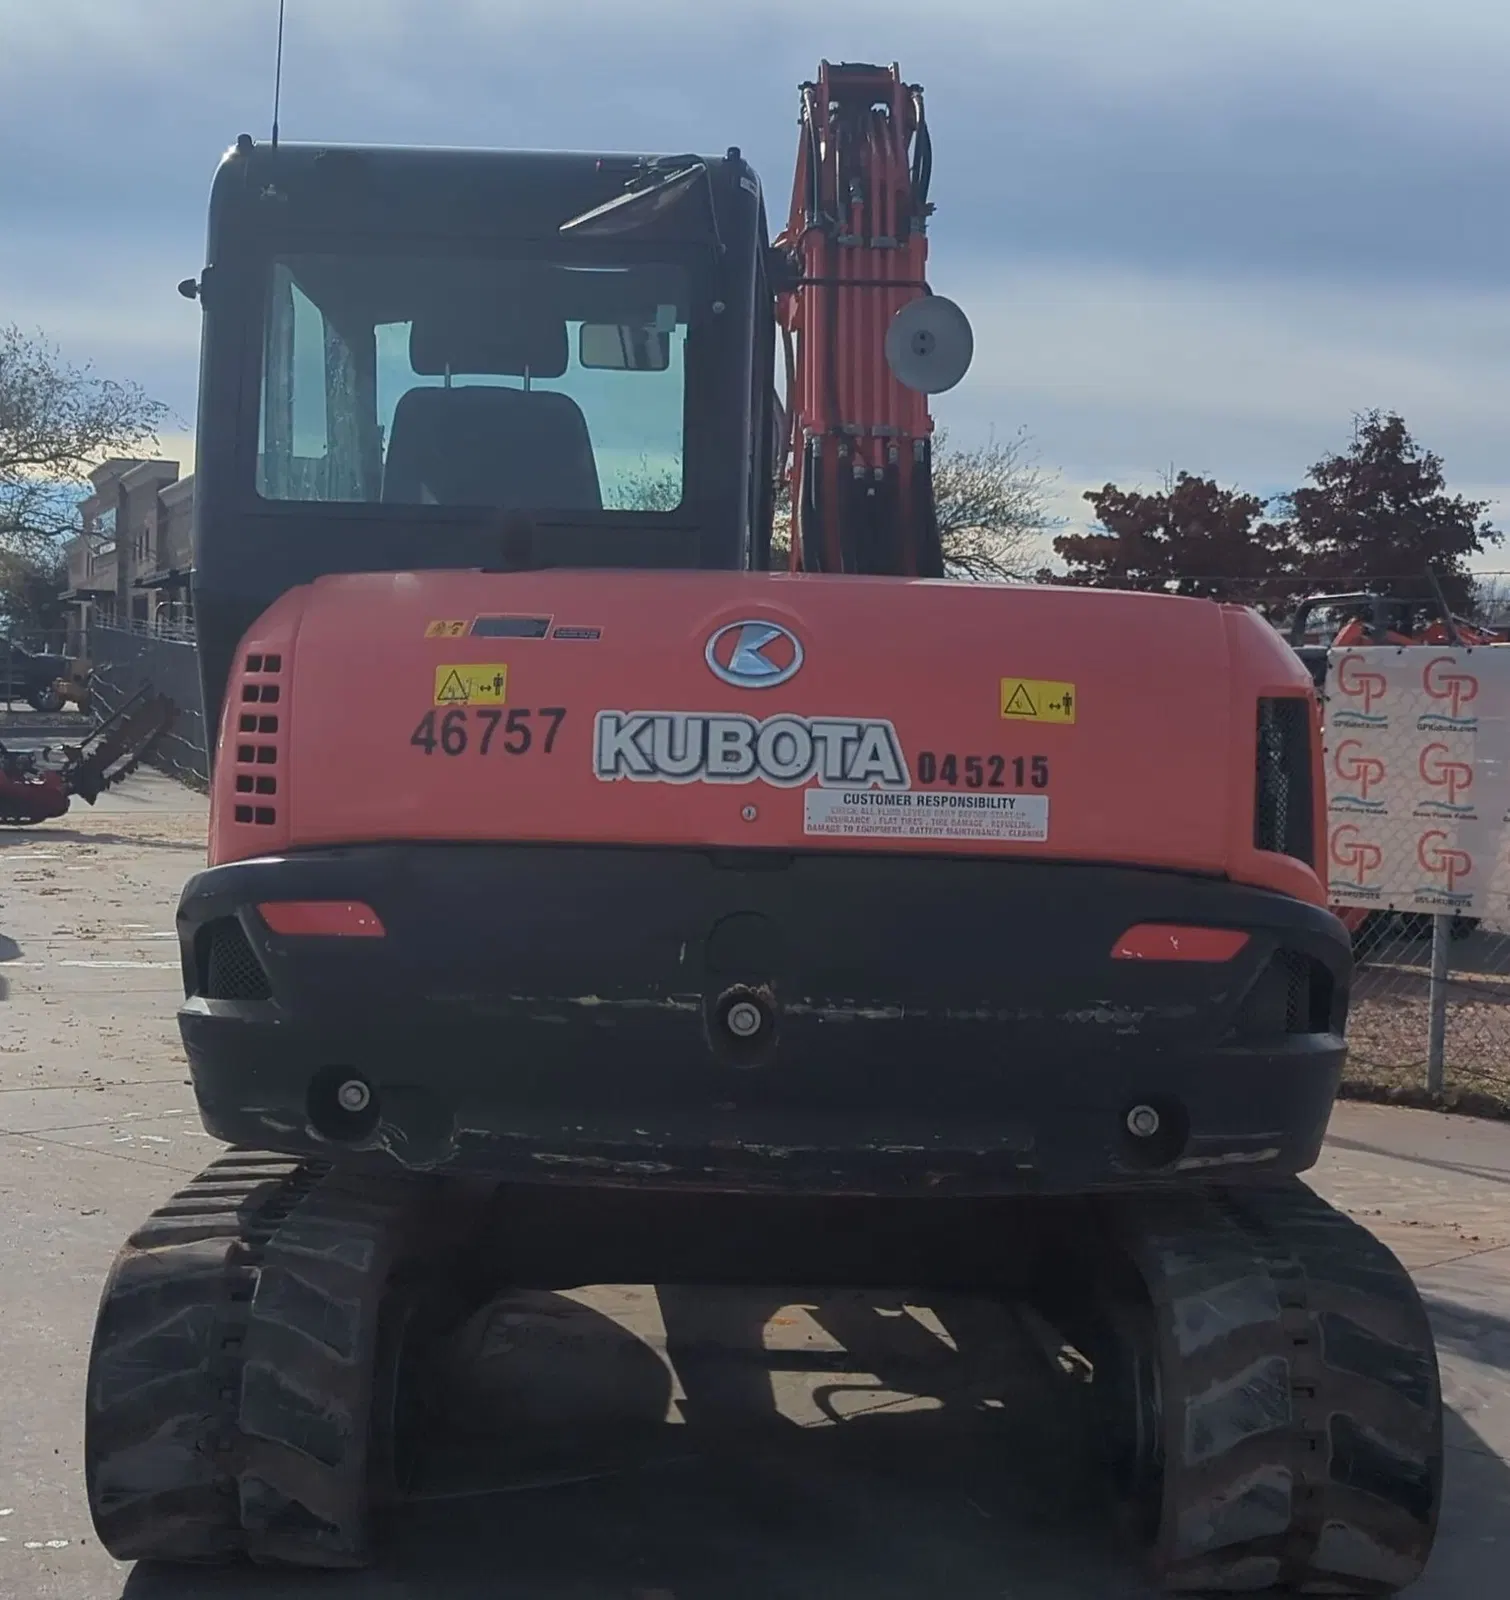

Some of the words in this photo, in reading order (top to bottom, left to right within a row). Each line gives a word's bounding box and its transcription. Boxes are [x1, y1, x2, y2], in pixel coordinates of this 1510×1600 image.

[1338, 654, 1387, 714] GP
[1423, 656, 1478, 718] GP
[410, 706, 567, 757] 46757
[599, 714, 906, 785] KUBOTA
[918, 750, 1049, 789] 045215
[1335, 739, 1384, 800] GP
[1419, 743, 1473, 804] GP
[807, 823, 841, 833] DAMAGE
[843, 824, 854, 832] TO
[909, 826, 943, 836] BATTERY
[946, 827, 1000, 838] MAINTENANCE
[843, 792, 912, 806] CUSTOMER
[916, 795, 1016, 809] RESPONSIBILITY
[1330, 824, 1382, 884] GP
[1417, 830, 1472, 891] GP
